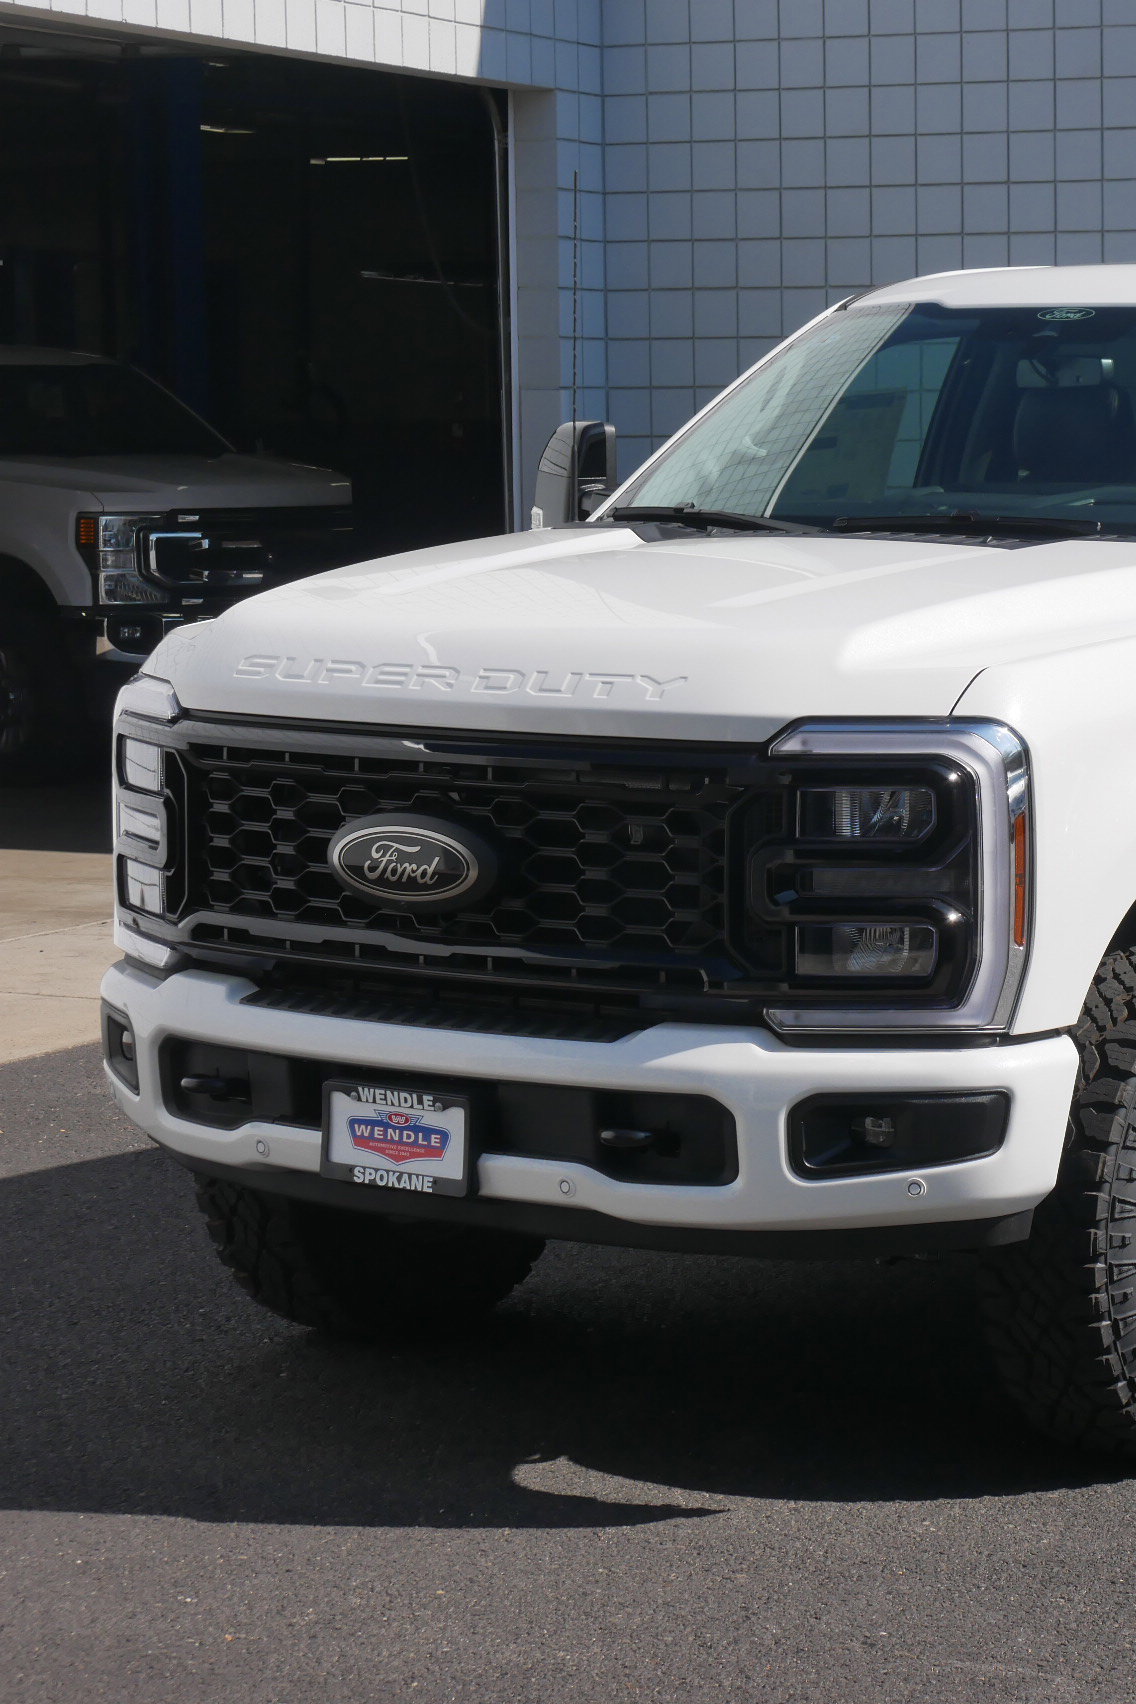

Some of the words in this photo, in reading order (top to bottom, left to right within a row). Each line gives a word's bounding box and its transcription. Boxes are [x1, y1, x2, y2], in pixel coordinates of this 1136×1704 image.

[233, 654, 461, 691] SUPER
[470, 665, 689, 701] DUTY
[363, 840, 441, 885] Ford
[357, 1086, 434, 1112] WENDLE
[354, 1123, 441, 1146] WENDLE
[353, 1166, 434, 1193] SPOKANE
